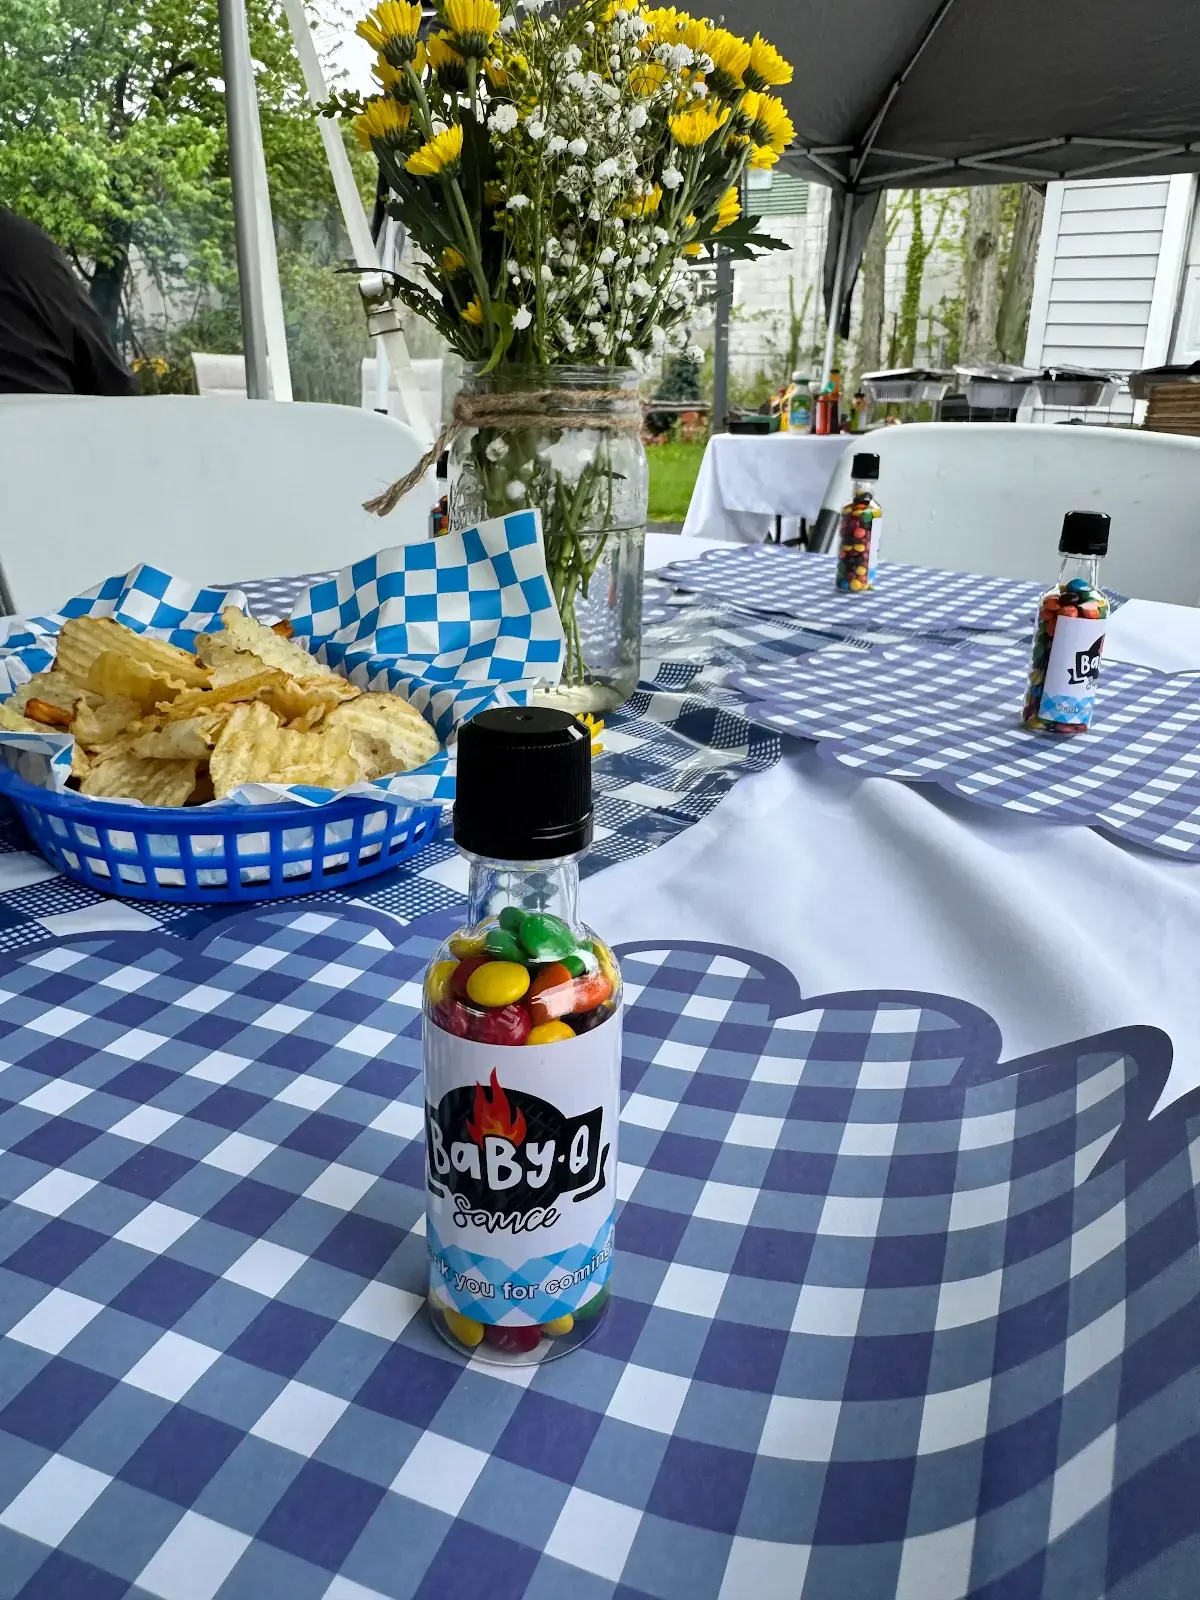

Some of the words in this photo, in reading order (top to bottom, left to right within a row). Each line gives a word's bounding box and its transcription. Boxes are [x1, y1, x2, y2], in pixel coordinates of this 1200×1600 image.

[453, 1192, 562, 1235] Sauce
[454, 1271, 496, 1299] you
[502, 1281, 540, 1301] for
